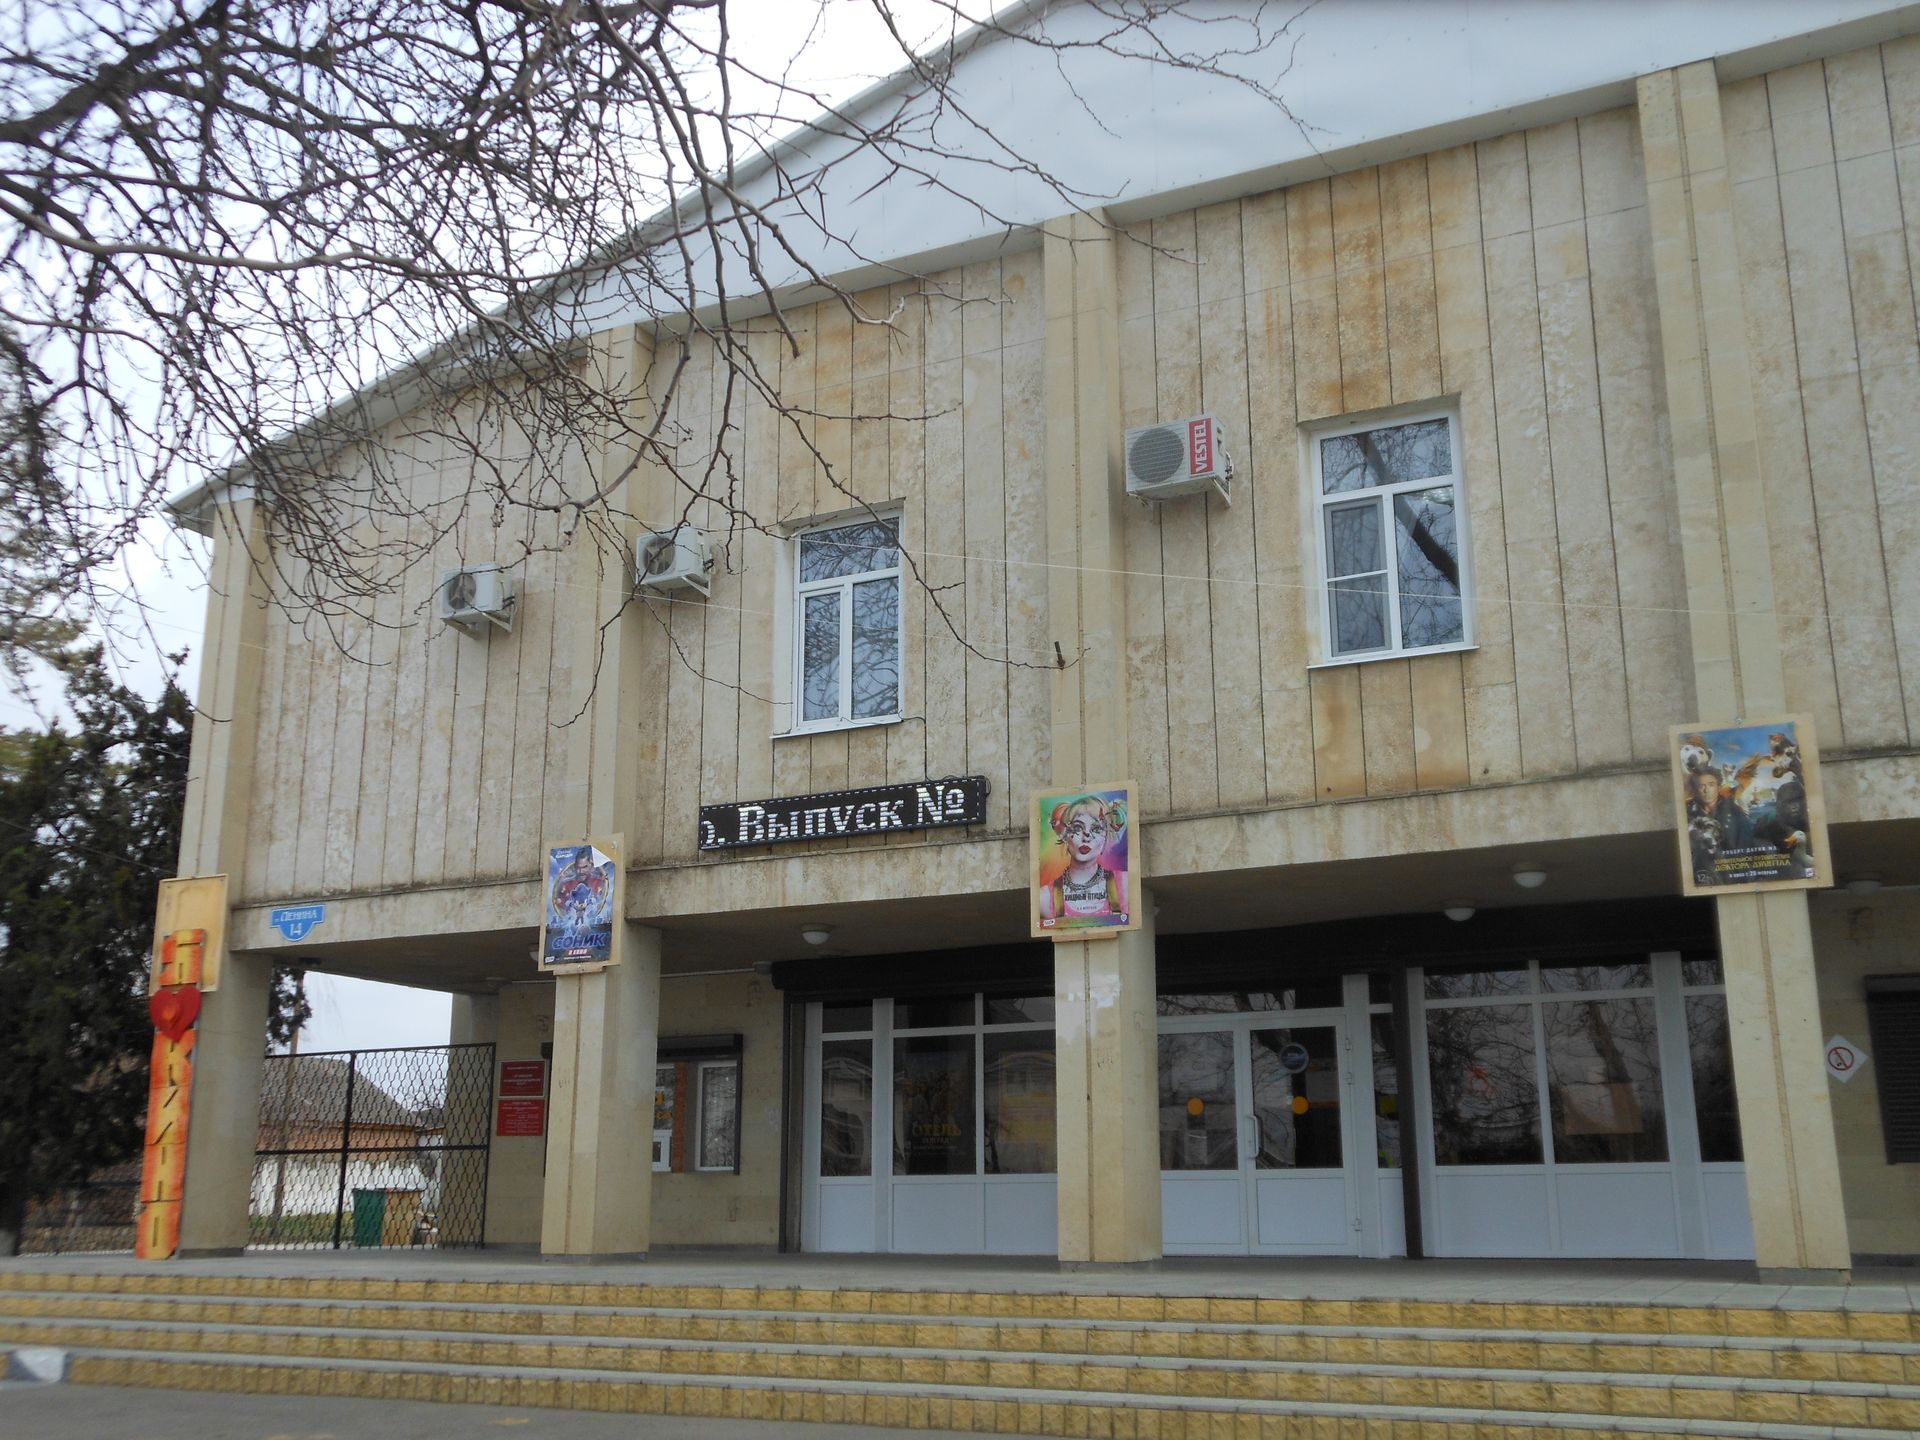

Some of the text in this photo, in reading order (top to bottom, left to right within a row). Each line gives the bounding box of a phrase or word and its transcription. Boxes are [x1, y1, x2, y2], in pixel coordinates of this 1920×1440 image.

[1194, 420, 1208, 472] VESTEL
[738, 798, 905, 841] Выпуск
[916, 785, 966, 824] №
[289, 922, 302, 936] 14
[552, 933, 606, 949] СОНИК
